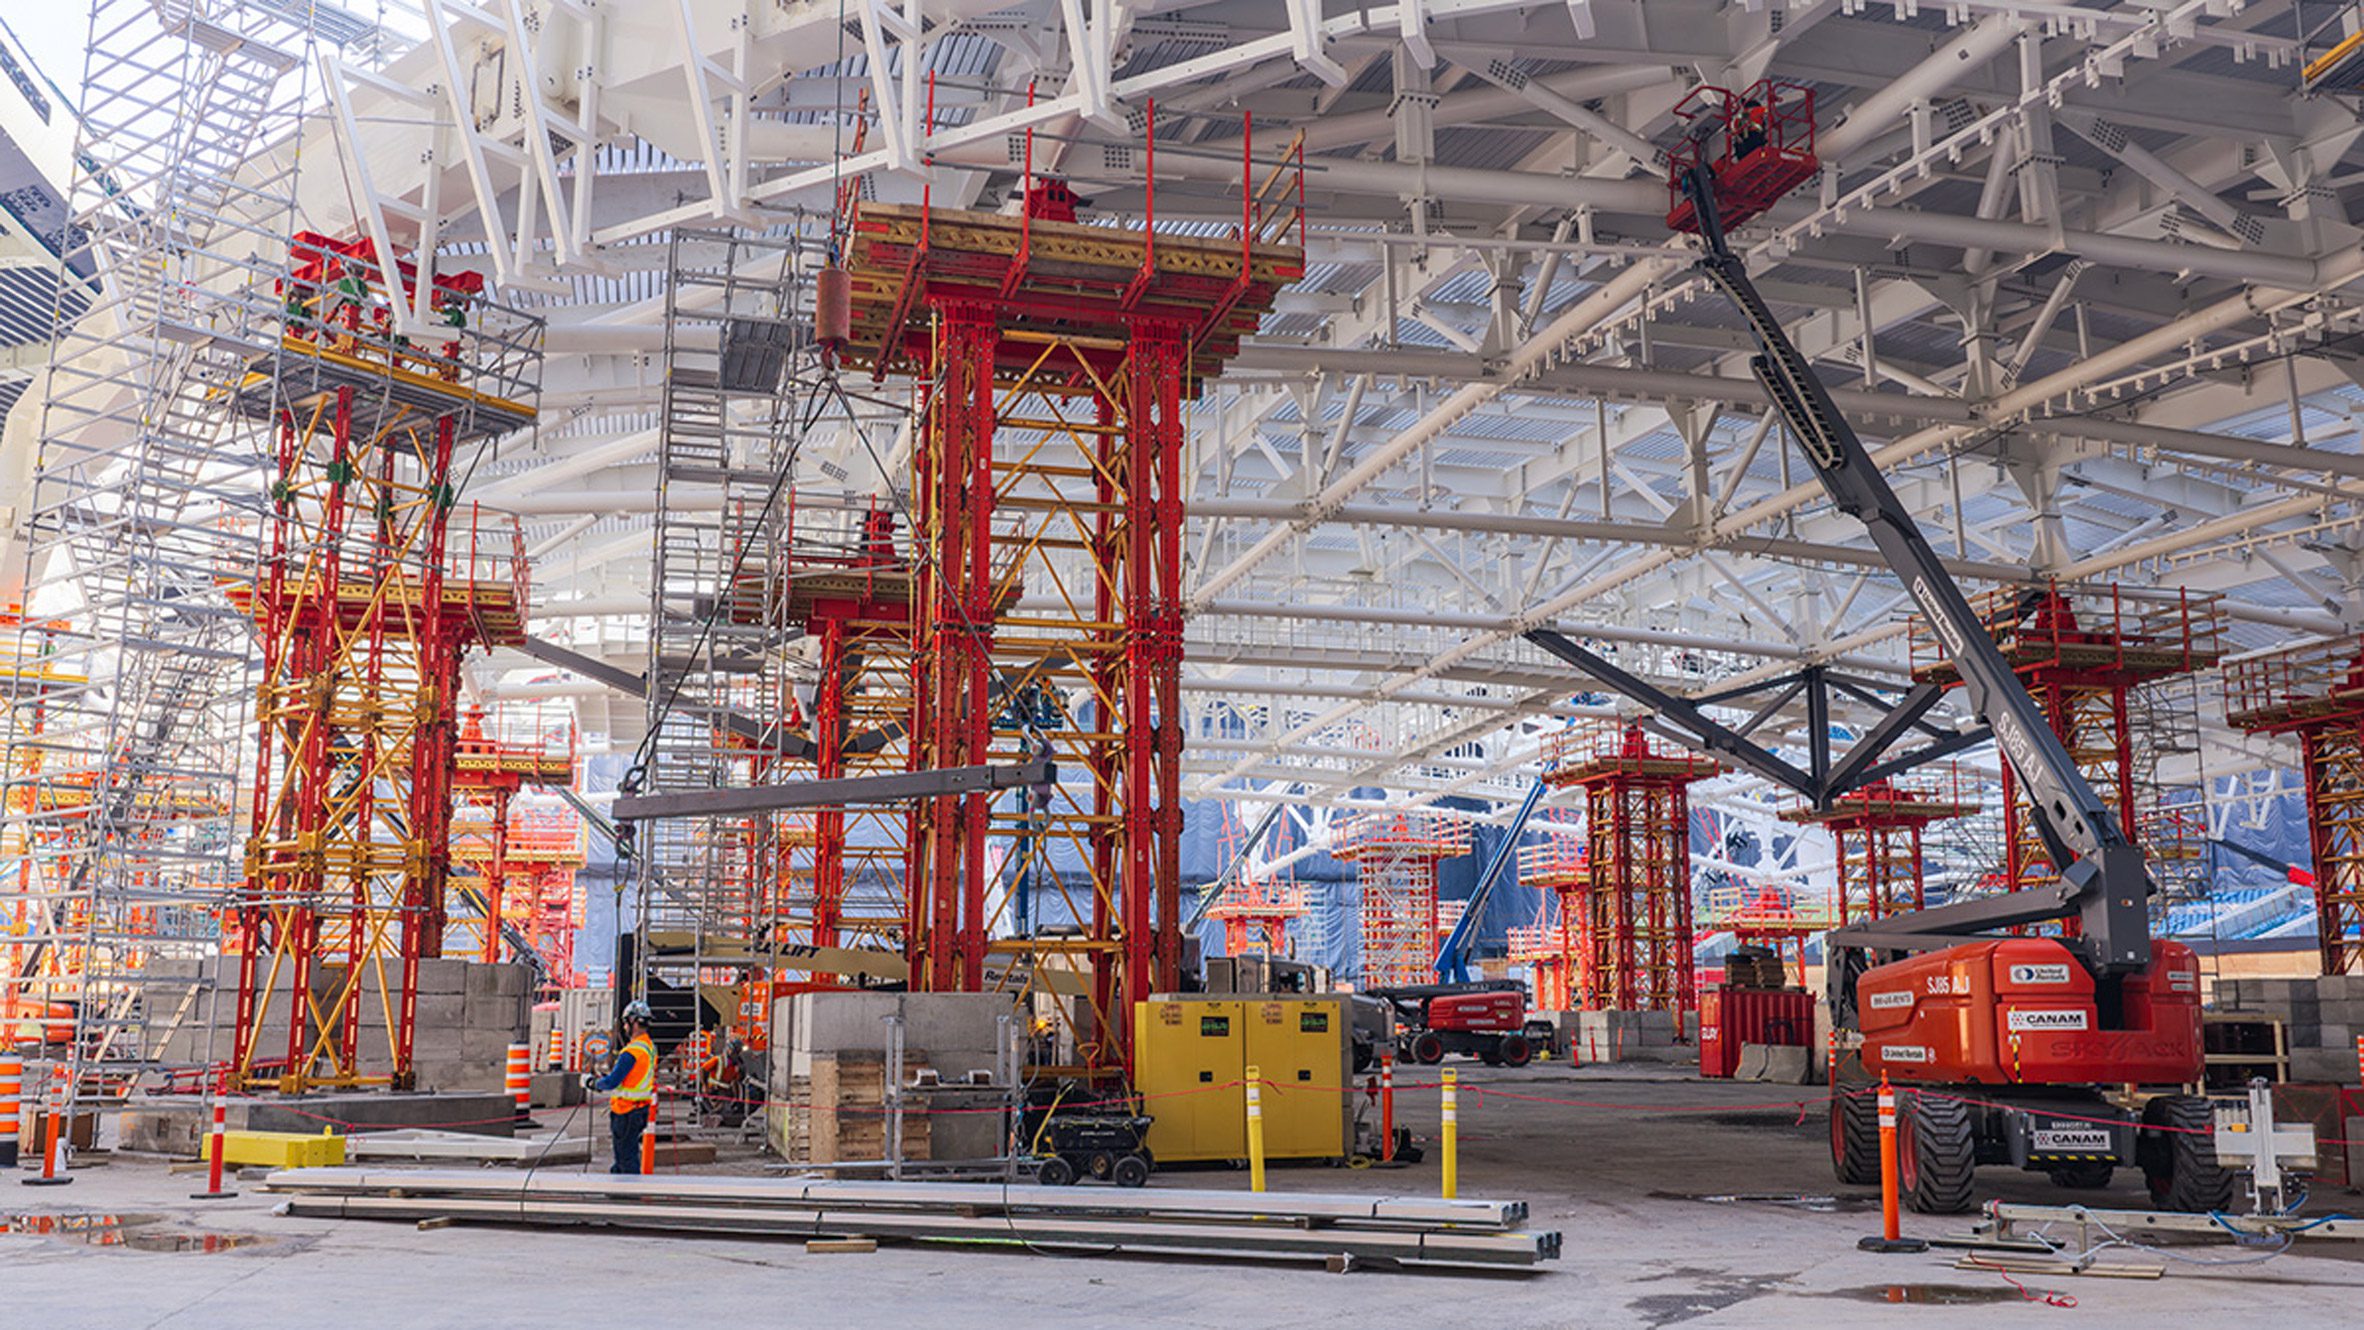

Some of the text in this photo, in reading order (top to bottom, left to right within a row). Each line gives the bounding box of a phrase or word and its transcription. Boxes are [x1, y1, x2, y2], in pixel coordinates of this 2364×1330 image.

[1997, 712, 2043, 783] SJ85 AJ
[1927, 976, 1970, 994] SJ85 AJ
[2026, 1014, 2082, 1023] CANAM
[2052, 1134, 2105, 1143] CANAM
